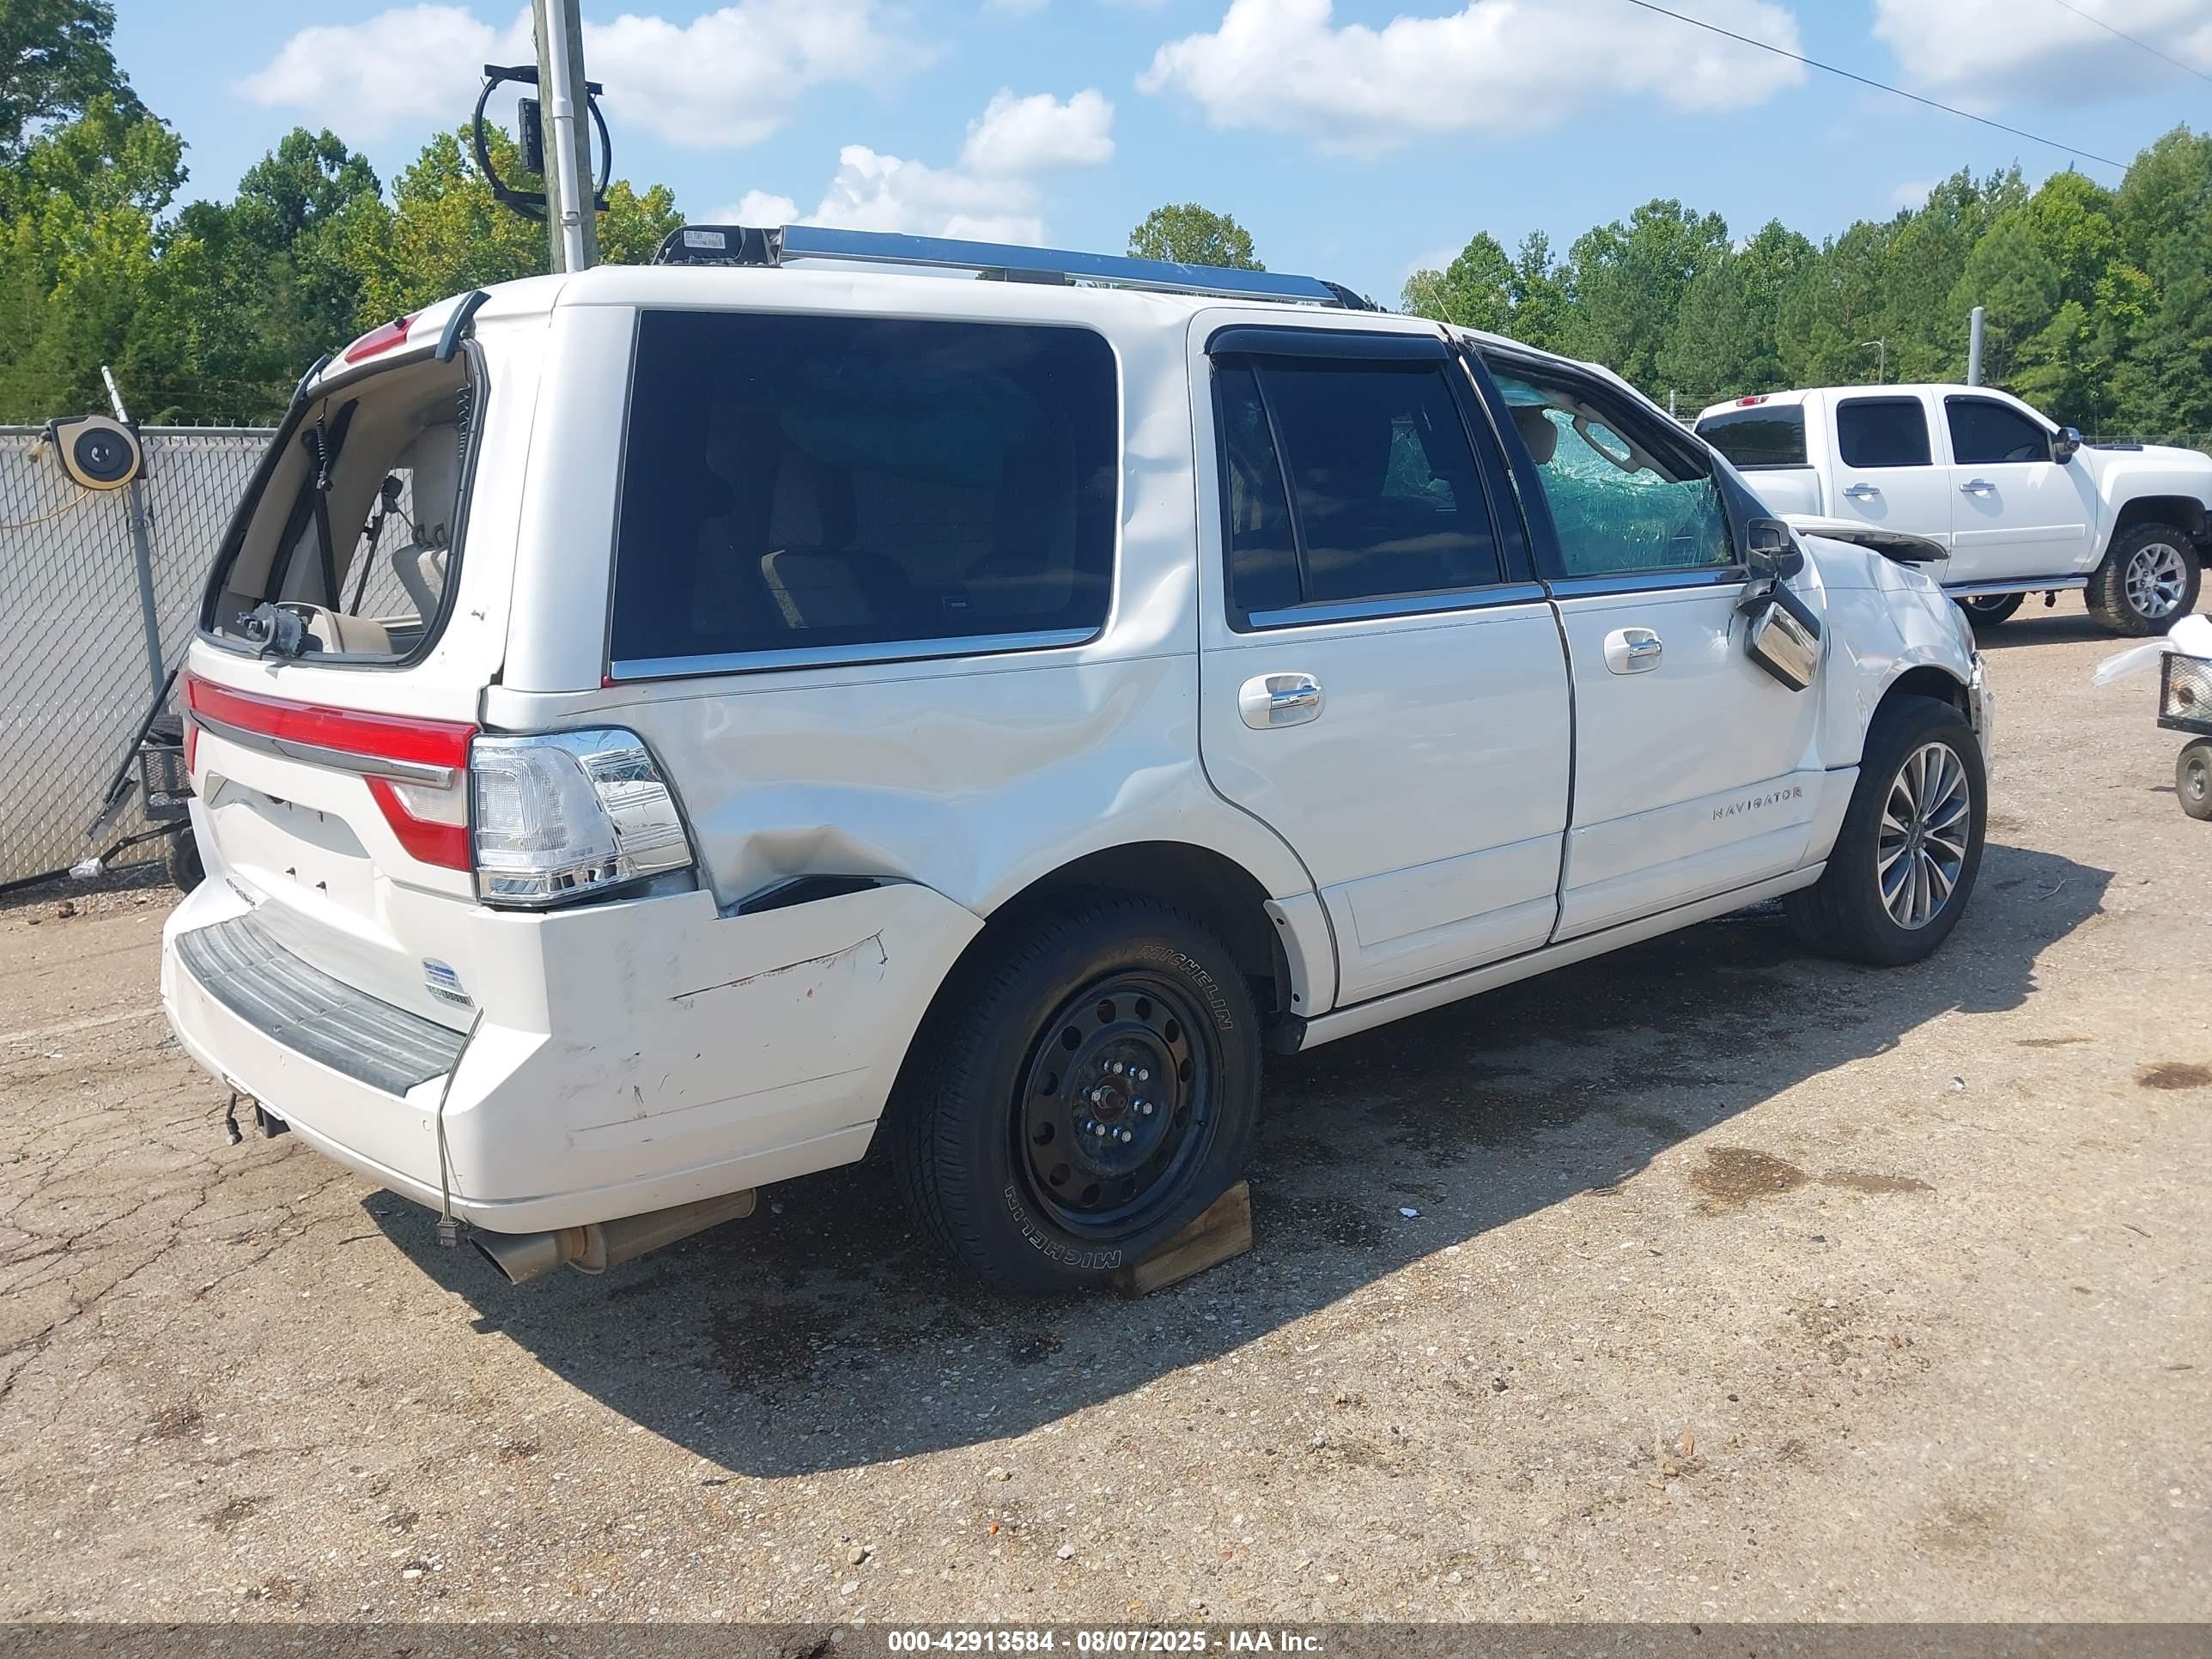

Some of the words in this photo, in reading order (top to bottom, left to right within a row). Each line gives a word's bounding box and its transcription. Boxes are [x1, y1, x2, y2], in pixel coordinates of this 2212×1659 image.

[1712, 786, 1802, 821] NAVIGATOR
[1135, 945, 1233, 1030] MICHELIN
[1004, 1185, 1122, 1269] MICHELIN
